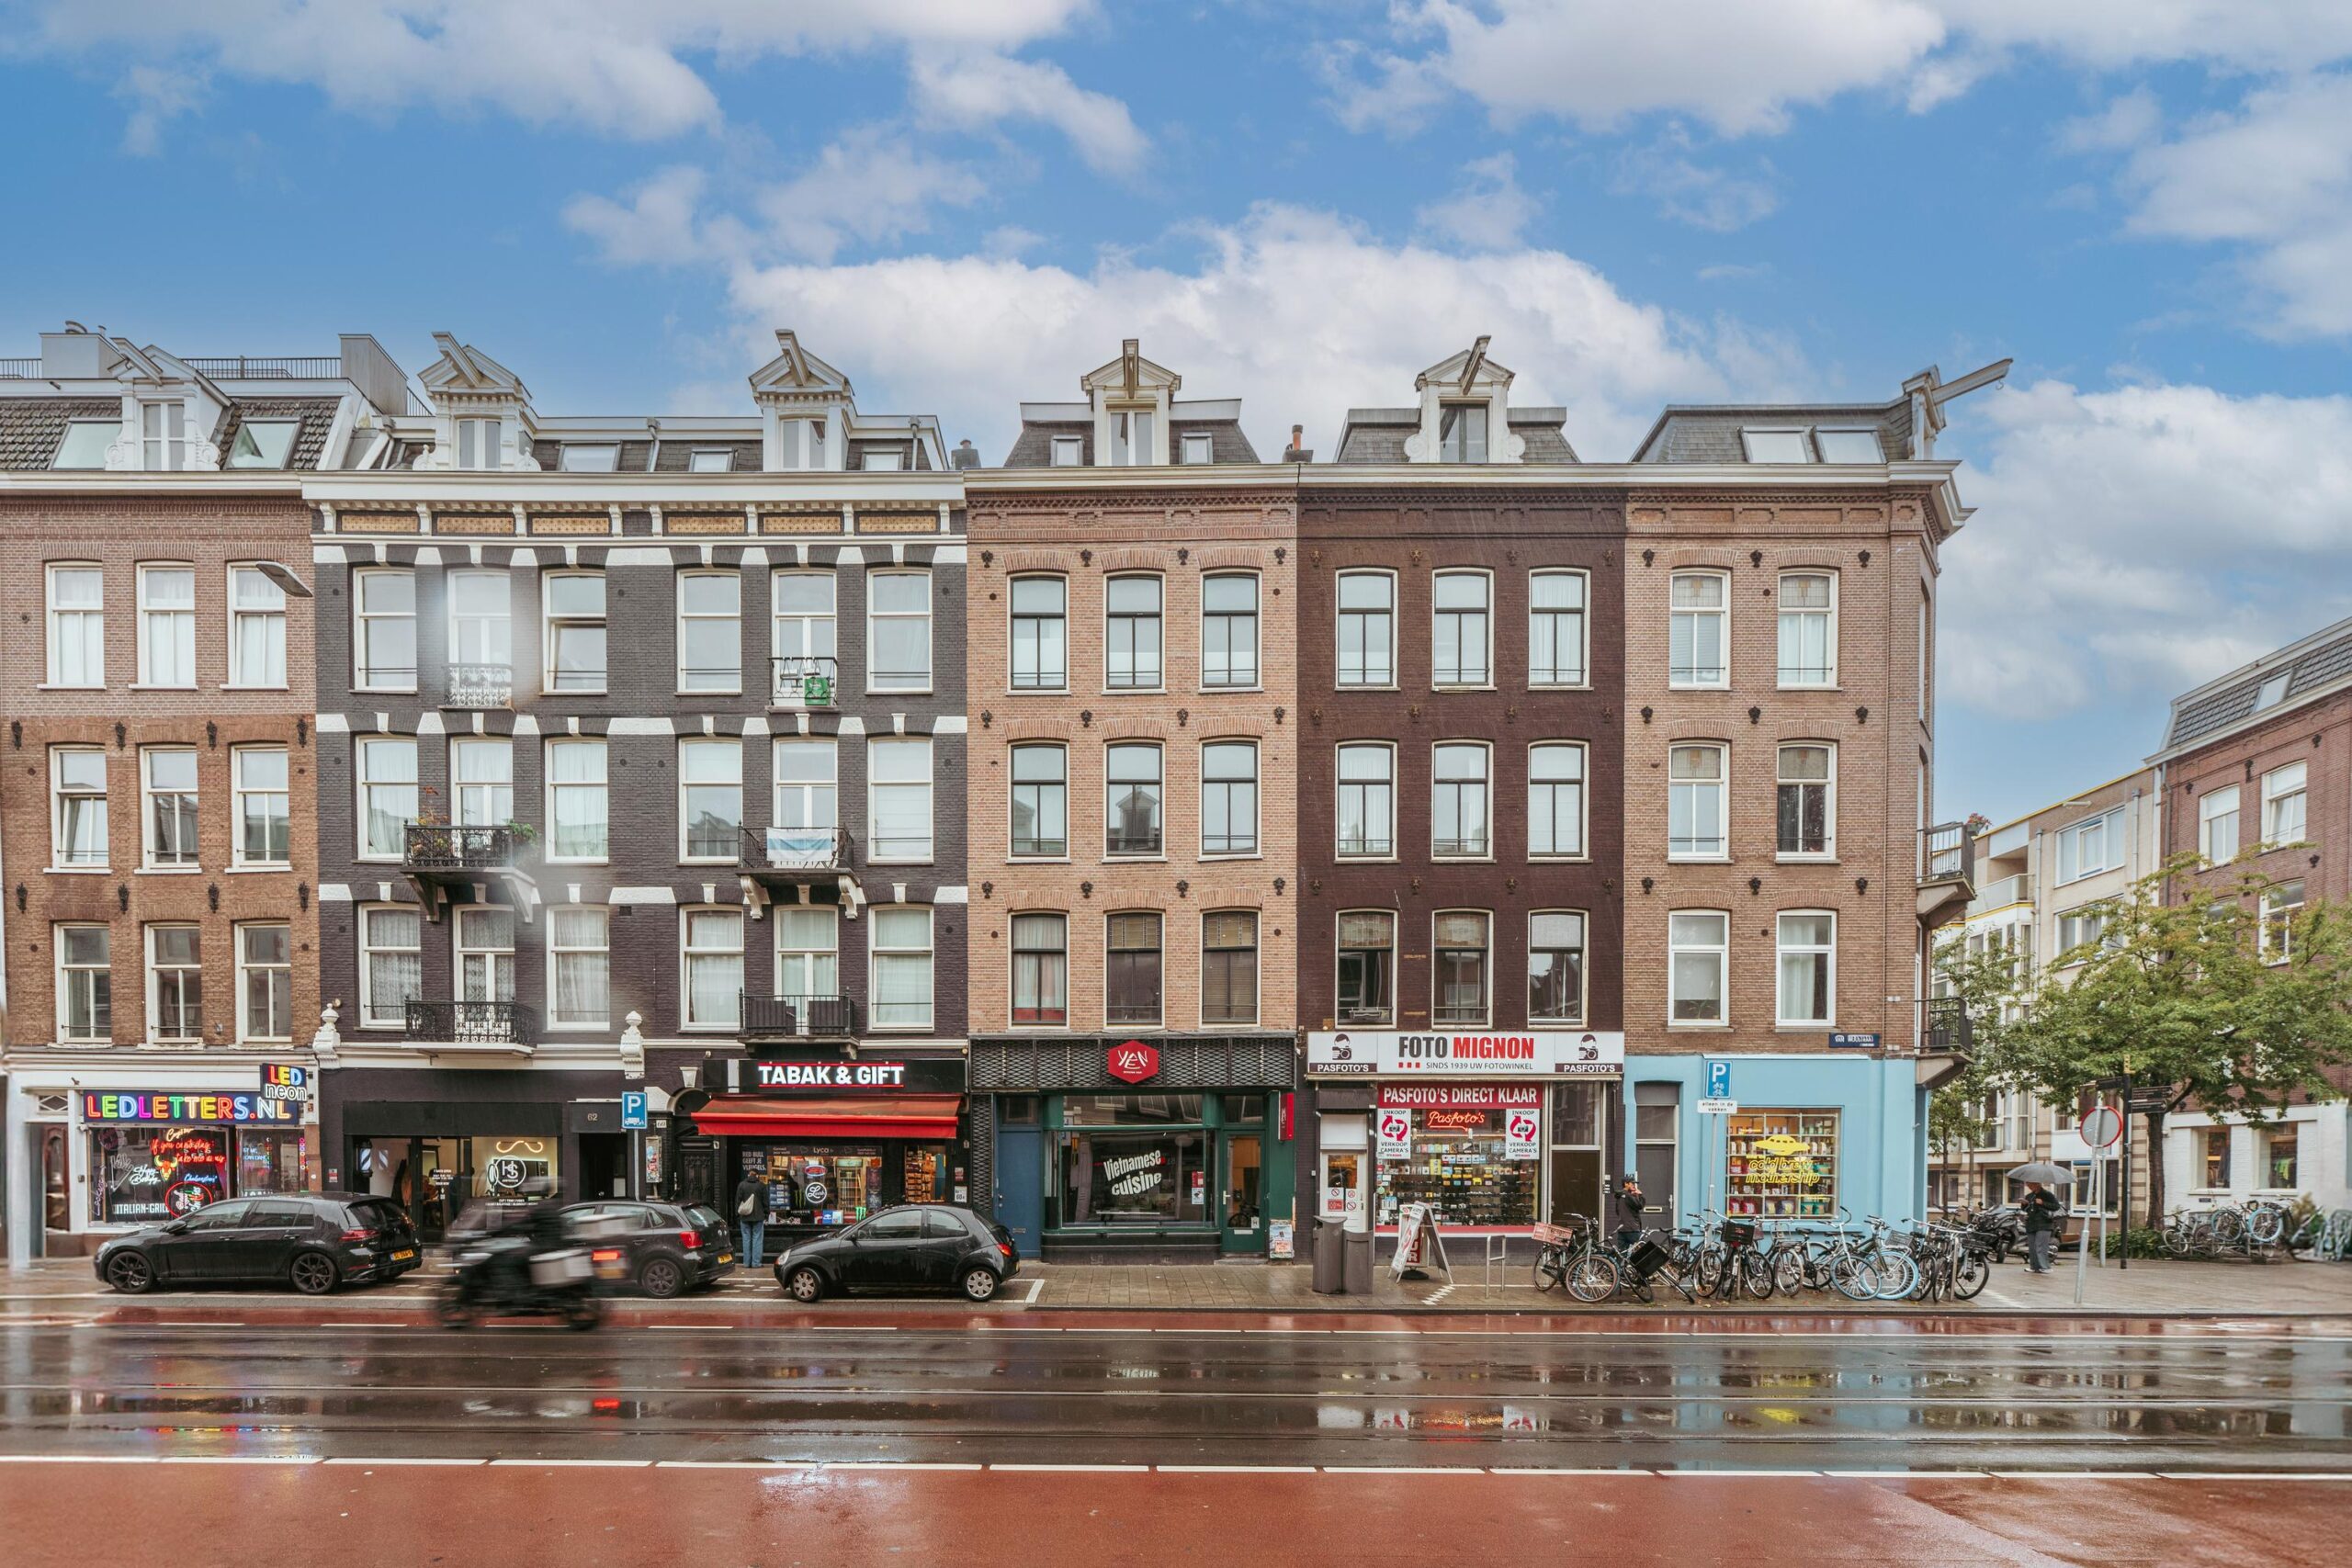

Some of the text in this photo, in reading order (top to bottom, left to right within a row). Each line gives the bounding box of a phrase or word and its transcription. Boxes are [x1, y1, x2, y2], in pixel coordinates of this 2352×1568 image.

[1398, 1036, 1534, 1059] FOTO MIGNON
[269, 1065, 301, 1085] LED
[758, 1066, 905, 1085] TABAK & GIFT
[1317, 1064, 1369, 1072] PASFOTO'S
[1484, 1062, 1533, 1070] FOTOWINKEL
[1564, 1065, 1615, 1073] PASFOTO'S
[1712, 1063, 1727, 1082] P
[265, 1082, 307, 1101] neon
[1384, 1088, 1537, 1103] PASFOTO'S DIRECT KLAAR
[86, 1095, 291, 1121] LEDLETTERS.NL
[628, 1095, 641, 1114] P
[1428, 1111, 1486, 1126] Pasfoto's
[1103, 1149, 1161, 1181] Vietnamese
[1111, 1170, 1162, 1196] cuisine
